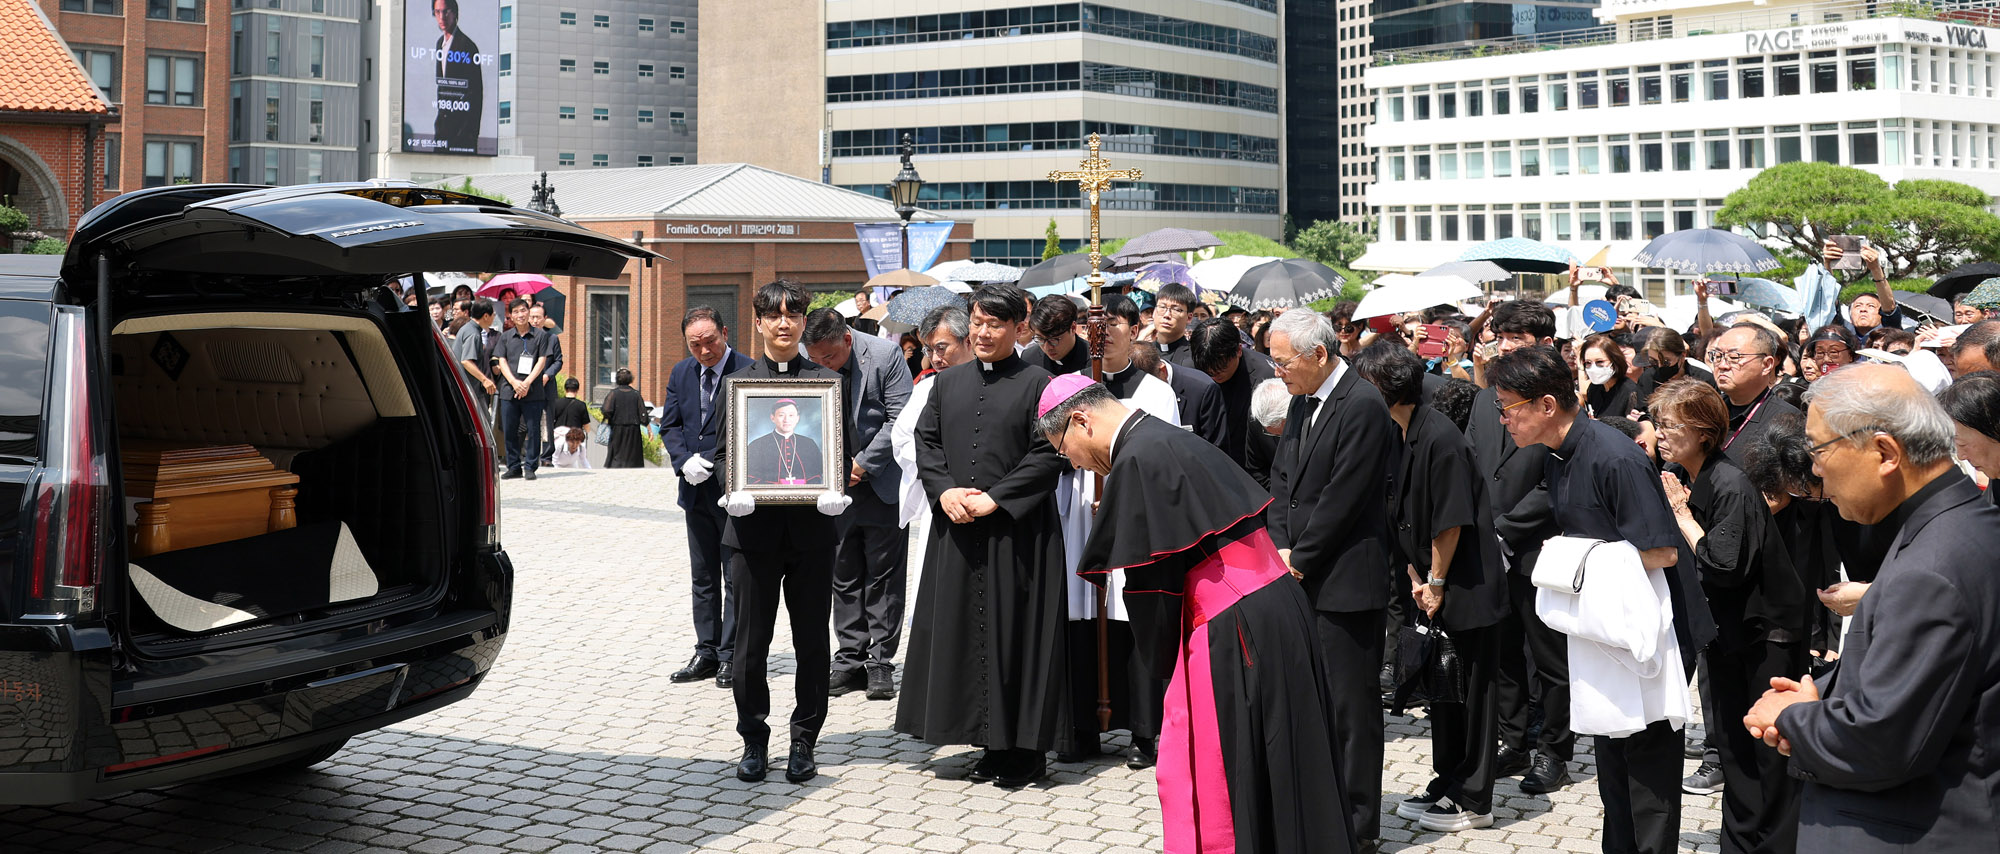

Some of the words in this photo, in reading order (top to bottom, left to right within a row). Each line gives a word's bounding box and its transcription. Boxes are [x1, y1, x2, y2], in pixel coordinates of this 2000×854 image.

[1811, 25, 1849, 35] MYEONG
[1945, 25, 1988, 49] YWCA
[1811, 39, 1838, 48] DONG
[411, 46, 426, 59] UP
[429, 48, 444, 61] TO
[447, 50, 471, 64] 30%
[473, 53, 494, 66] OFF
[331, 221, 425, 238] ESCALADE
[666, 223, 699, 235] Familia
[701, 223, 732, 237] Chapel
[777, 223, 794, 235] 채플
